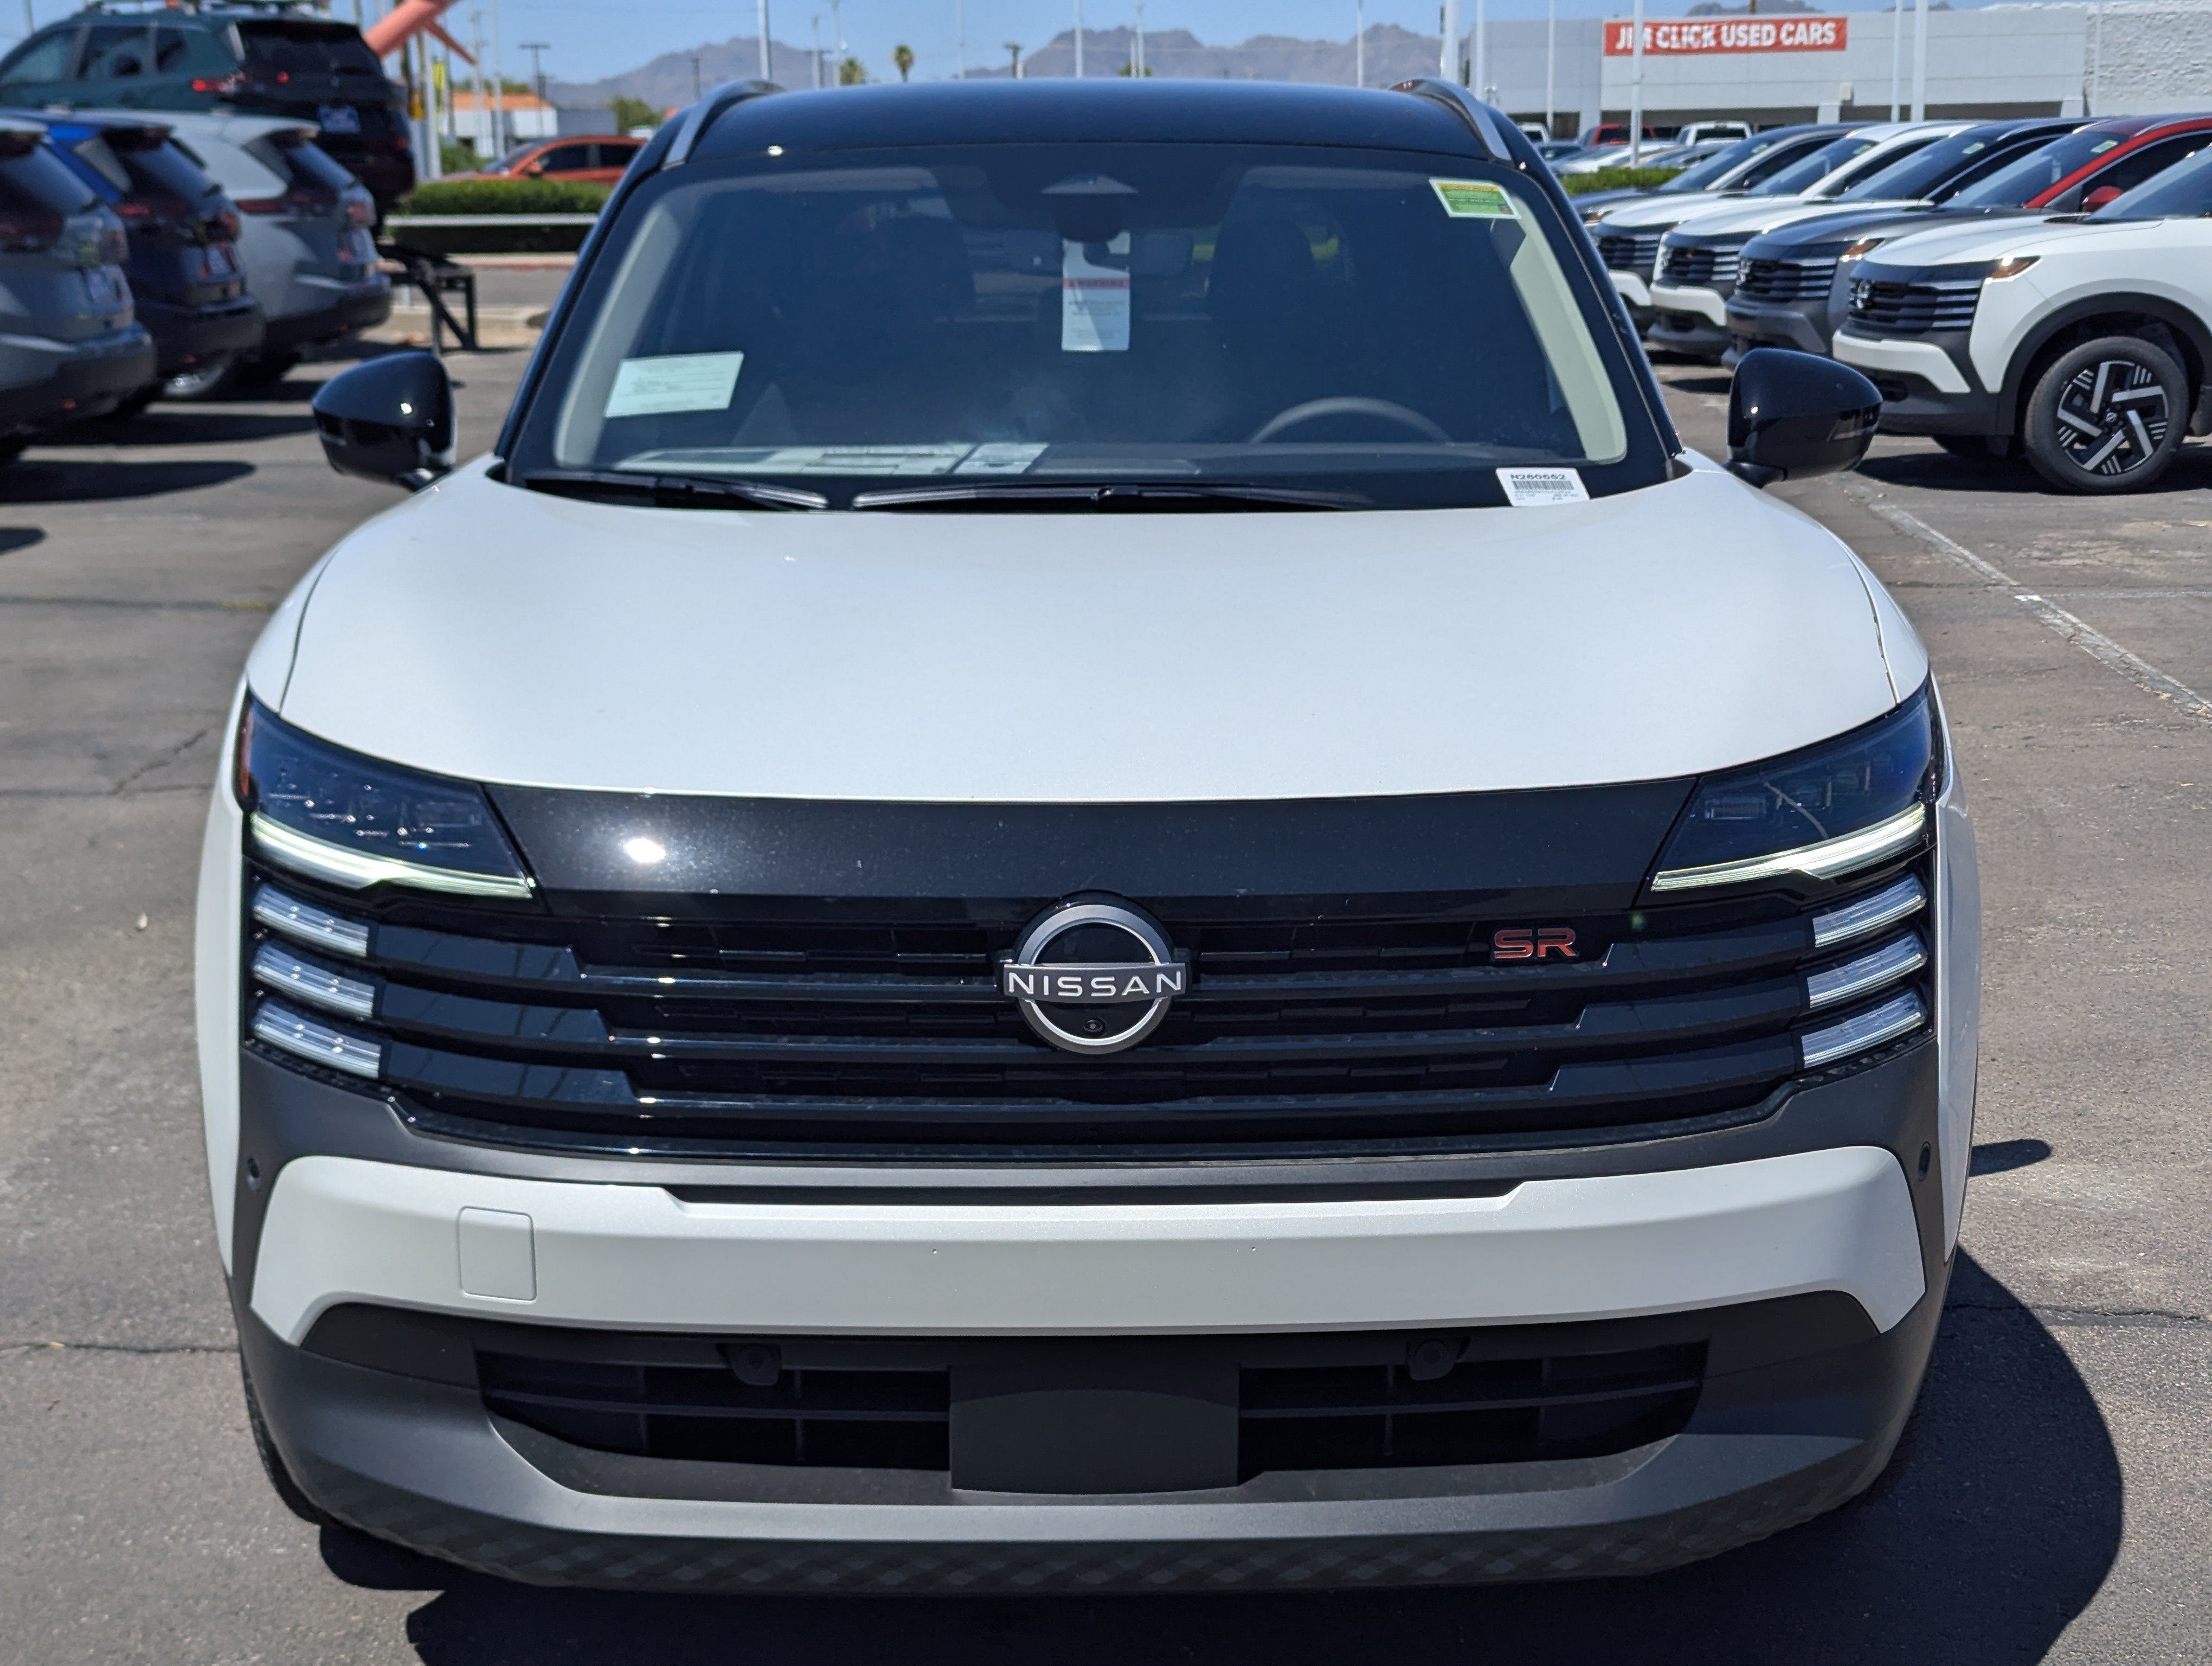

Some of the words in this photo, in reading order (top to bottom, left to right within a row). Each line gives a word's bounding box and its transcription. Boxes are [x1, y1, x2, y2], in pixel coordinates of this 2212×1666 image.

[1656, 25, 1717, 48] CLICK
[1721, 23, 1776, 47] USED
[1780, 21, 1836, 46] CARS
[1494, 927, 1576, 959] SR
[1008, 970, 1181, 997] NISSAN
